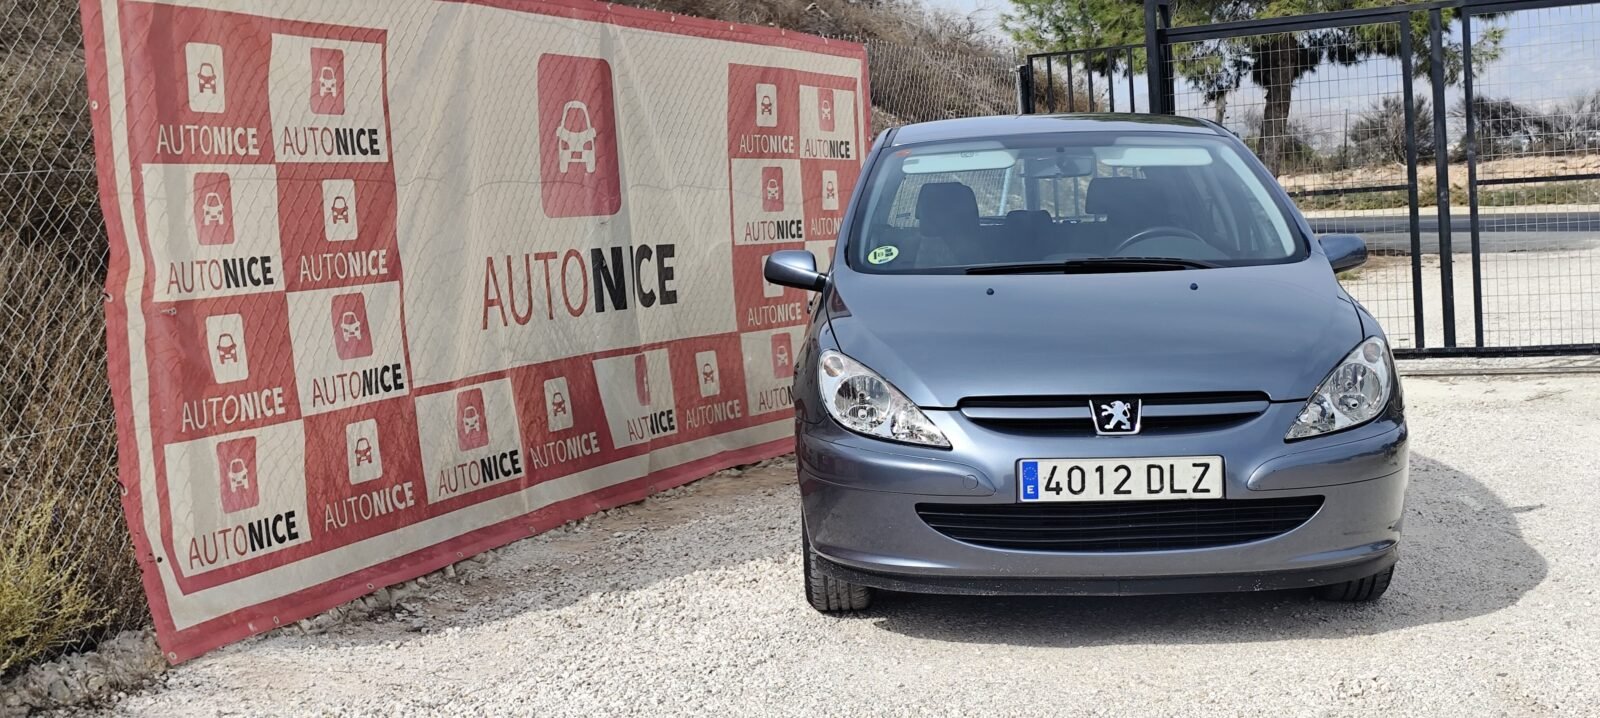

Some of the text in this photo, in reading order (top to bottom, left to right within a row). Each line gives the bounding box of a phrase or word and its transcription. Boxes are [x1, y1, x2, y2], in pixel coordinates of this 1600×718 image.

[157, 123, 260, 156] AUTONICE
[283, 126, 380, 156] AUTONICE
[739, 134, 795, 154] AUTONICE
[804, 138, 850, 159] AUTONICE
[744, 219, 803, 242] AUTONICE
[811, 217, 843, 236] AUTON
[166, 256, 274, 295] AUTONICE
[300, 249, 388, 283] AUTONICE
[482, 243, 678, 330] AUTONCE
[747, 302, 802, 326] AUTONICE
[312, 363, 405, 408] AUTONICE
[758, 385, 794, 411] AUTON
[181, 387, 286, 433] AUTONICE
[686, 399, 742, 430] AUTONICE
[529, 431, 601, 470] AUTONICE
[438, 449, 523, 496] AUTONICE
[1044, 463, 1211, 495] 4012 DLZ
[1027, 485, 1035, 494] E
[323, 481, 415, 532] AUTONICE
[189, 510, 300, 570] AUTONICE
